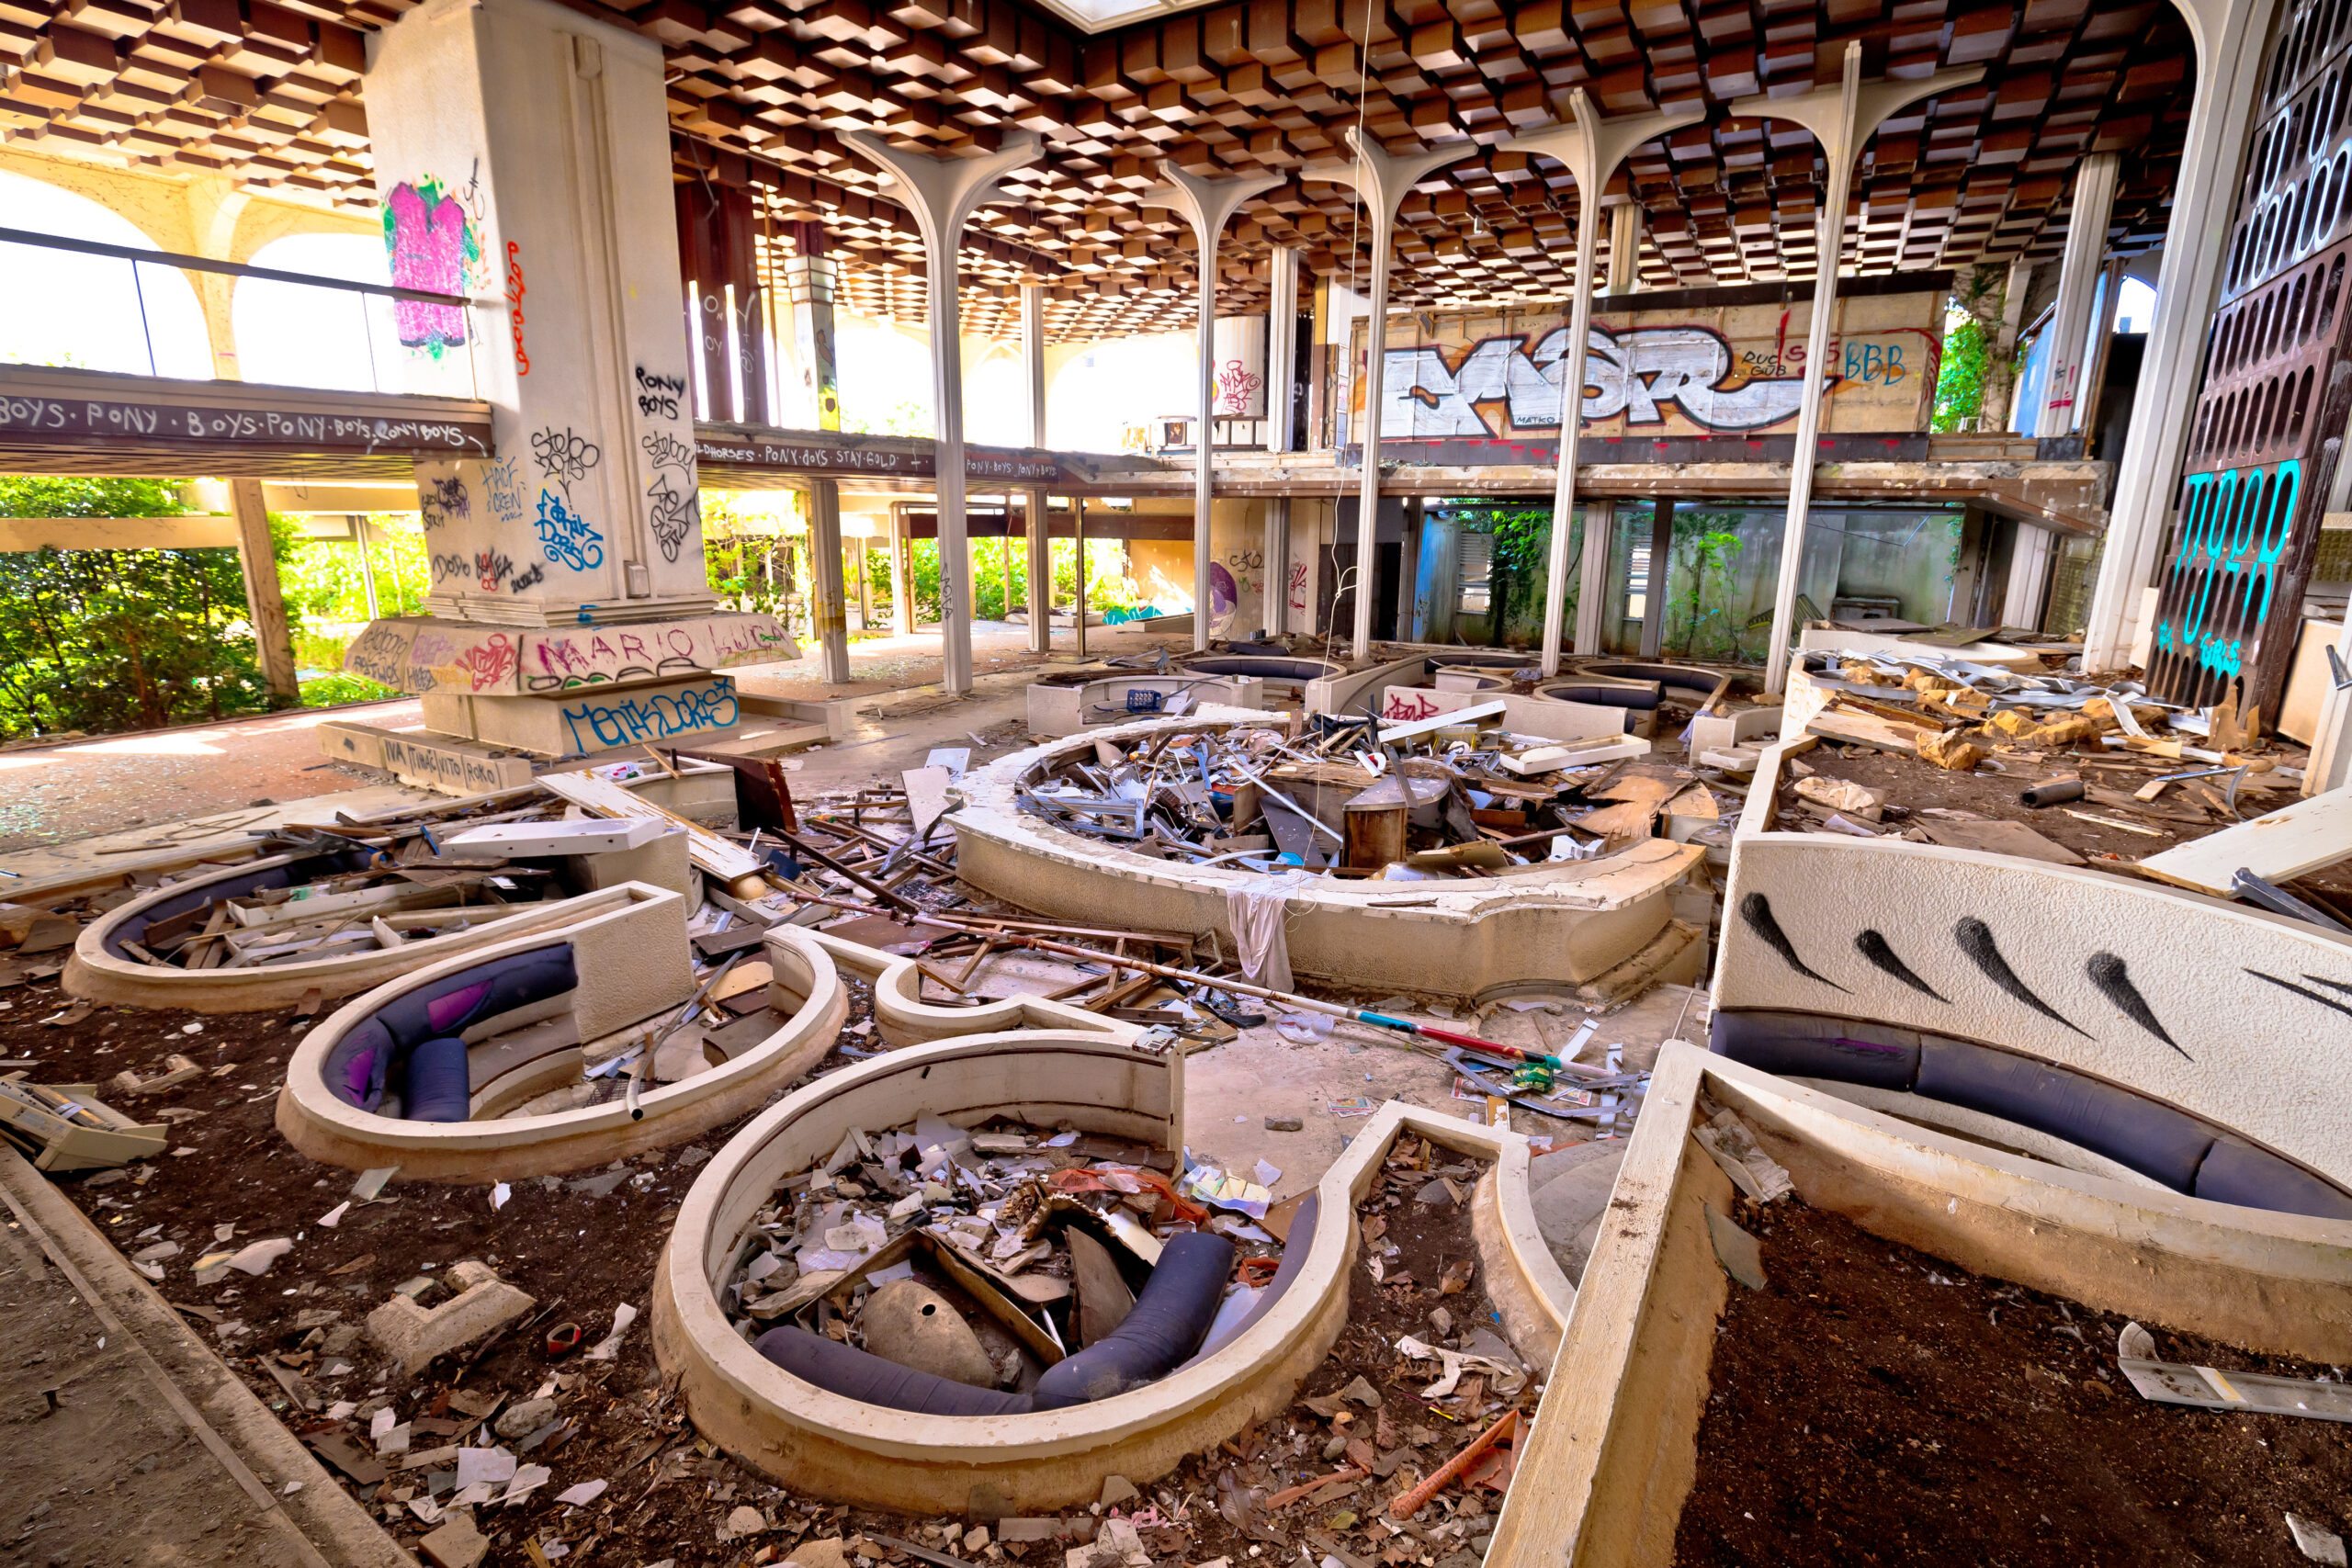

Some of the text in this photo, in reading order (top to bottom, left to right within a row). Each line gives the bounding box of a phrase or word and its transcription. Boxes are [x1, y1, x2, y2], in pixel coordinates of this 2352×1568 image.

[1845, 341, 1905, 386] BBB
[636, 367, 685, 399] PONY
[639, 395, 678, 420] BOYS
[1515, 415, 1555, 424] MATKO
[86, 402, 157, 434] PONY
[187, 411, 257, 438] BOYS
[266, 412, 325, 441] PONY
[334, 418, 371, 439] BOYS
[420, 423, 466, 446] BOYS
[765, 445, 797, 467] PONY
[836, 449, 862, 463] STAY
[866, 451, 897, 468] GOLD
[967, 458, 989, 474] PONY
[993, 460, 1012, 473] BOYS
[1017, 462, 1035, 477] PONY
[537, 627, 695, 675] MARIO
[384, 739, 407, 765] IVA
[466, 761, 495, 784] ROKO
